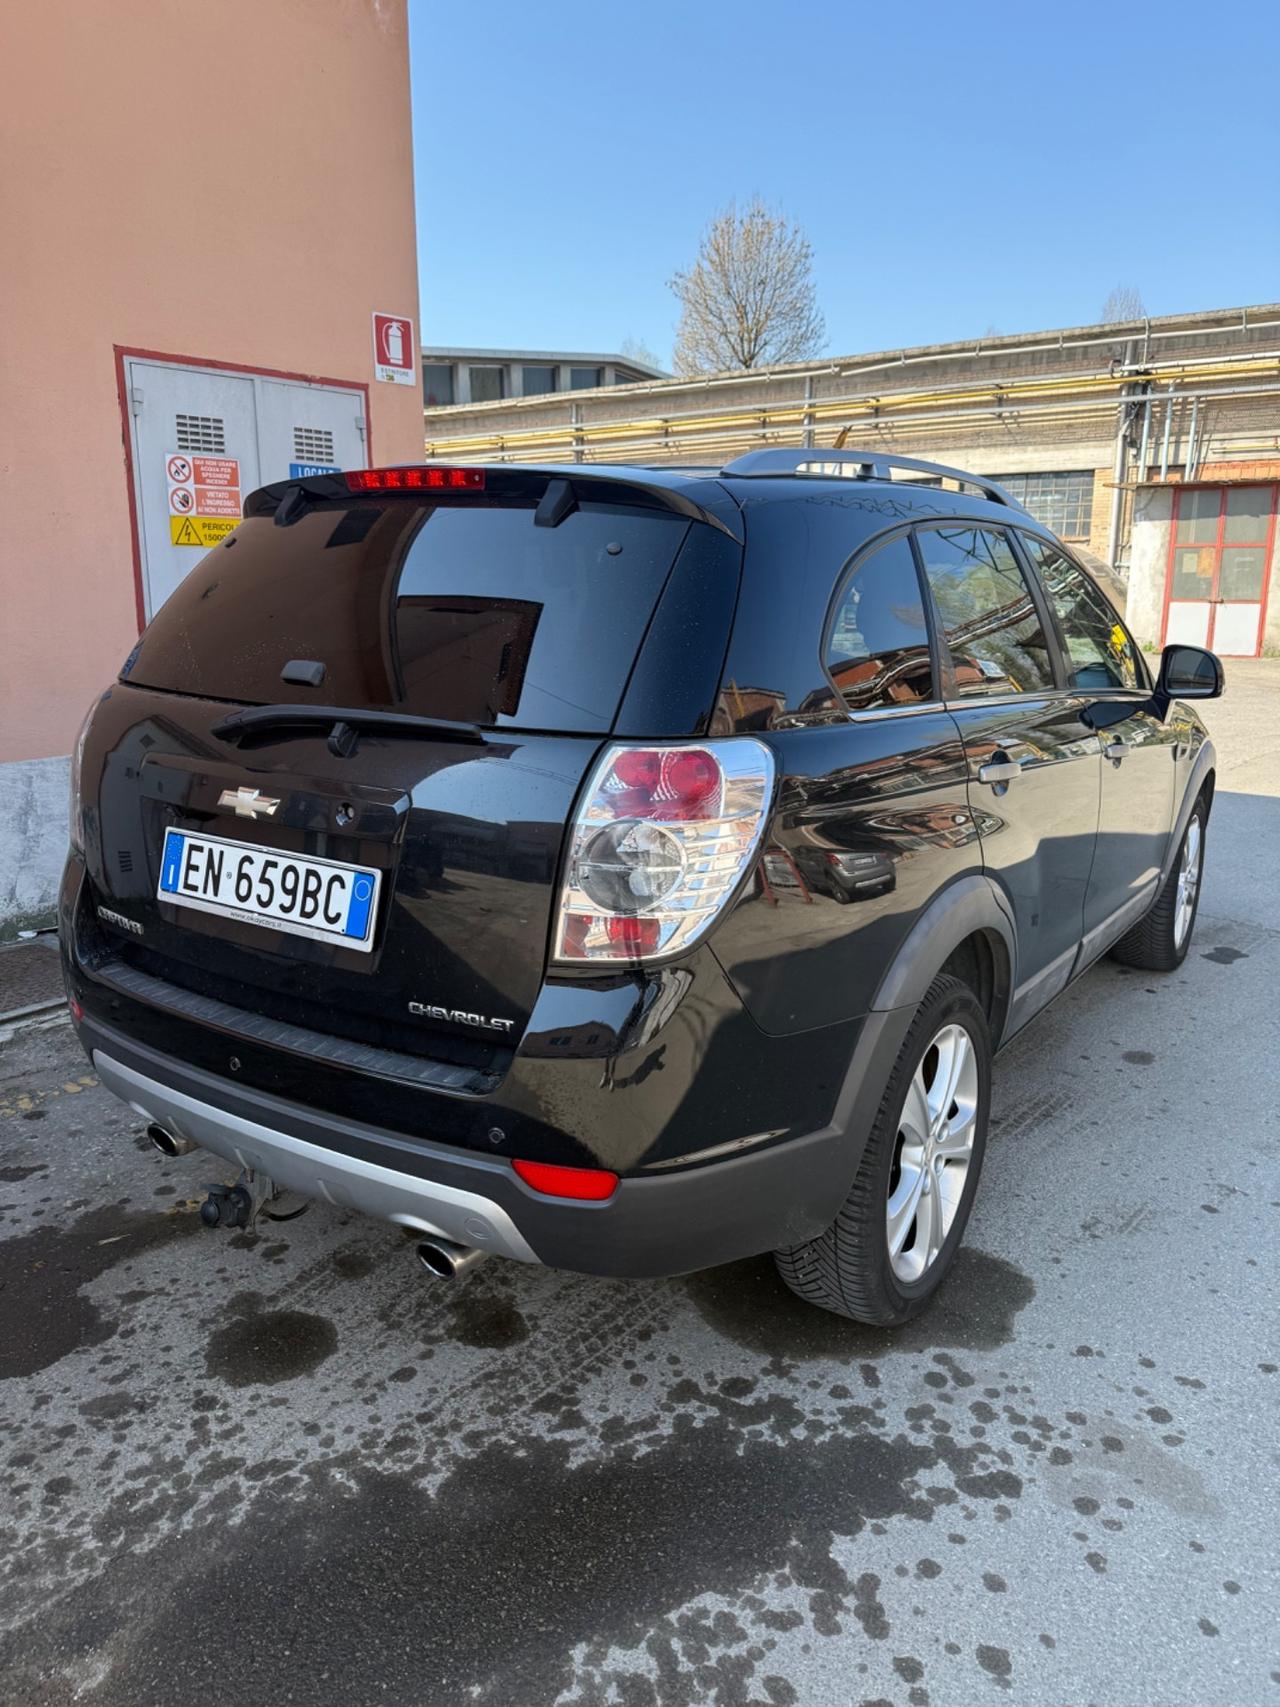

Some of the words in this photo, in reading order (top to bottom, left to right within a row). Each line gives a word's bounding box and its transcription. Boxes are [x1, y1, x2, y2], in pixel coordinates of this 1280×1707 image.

[202, 522, 236, 531] PERICOL
[183, 843, 224, 897] EN
[235, 855, 346, 925] 659BC
[408, 1001, 514, 1032] CHEVROLET
